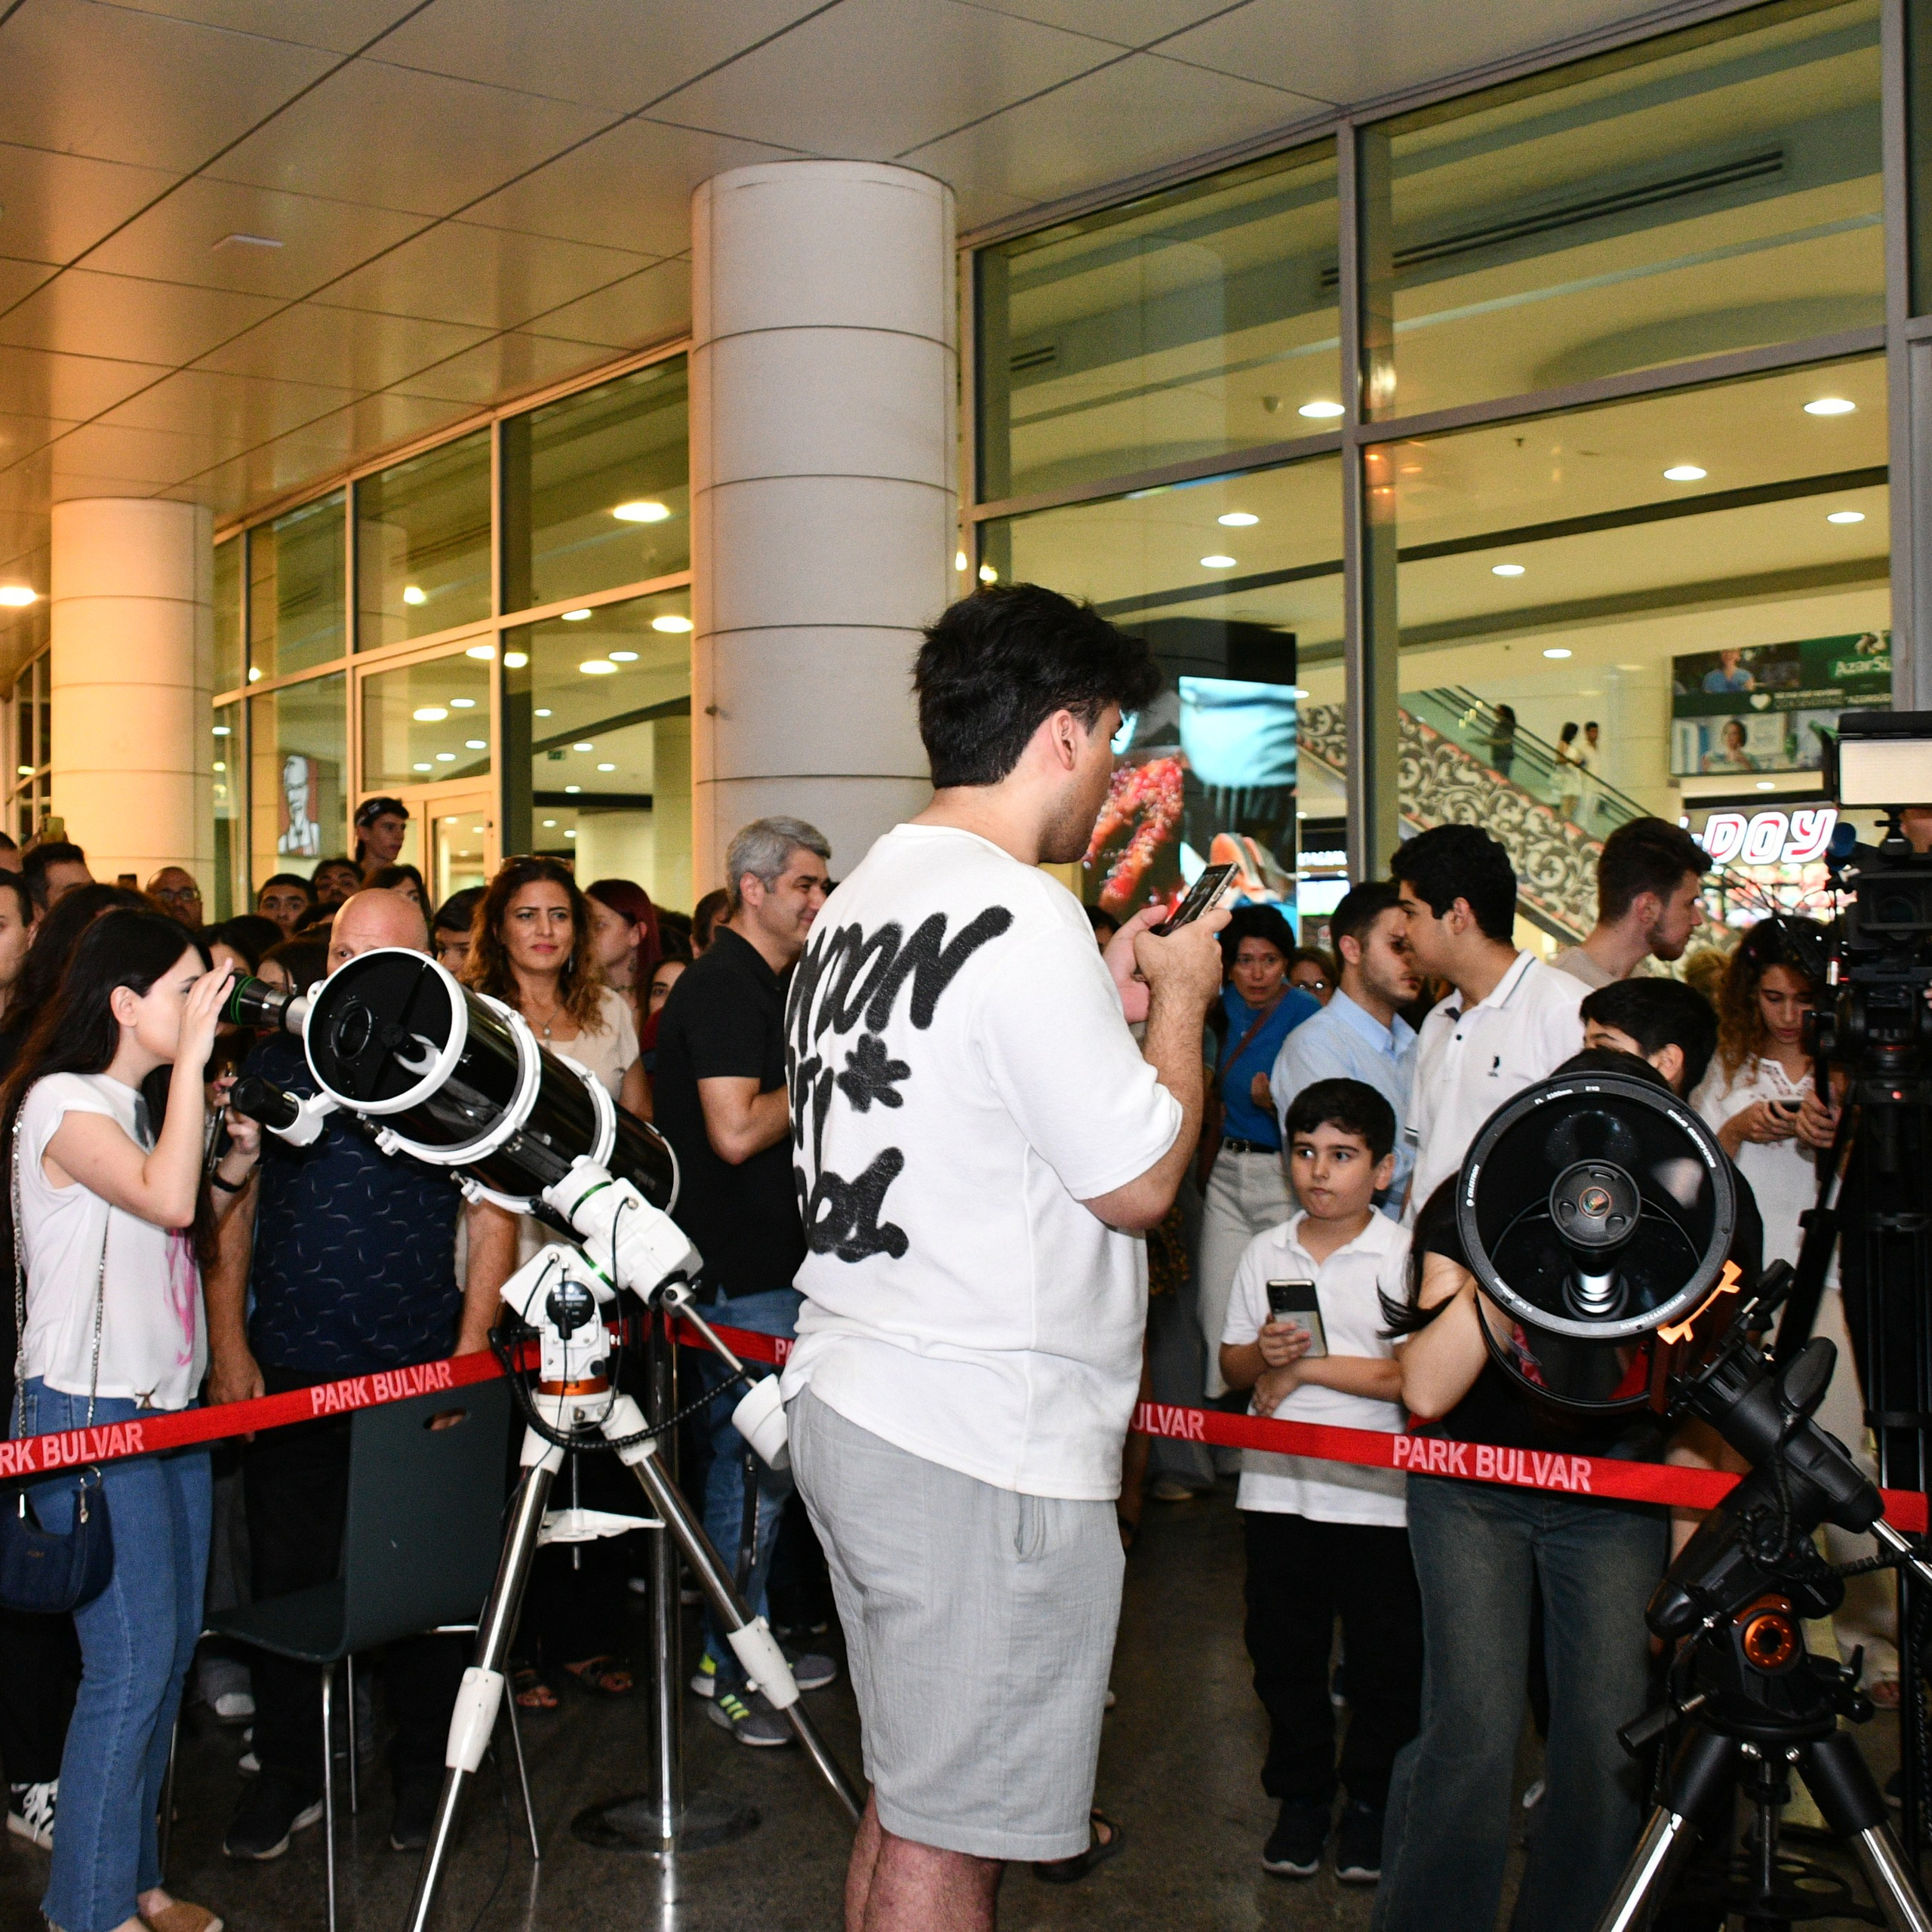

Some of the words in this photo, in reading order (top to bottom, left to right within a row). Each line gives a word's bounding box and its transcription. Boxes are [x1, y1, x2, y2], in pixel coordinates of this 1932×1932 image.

[1702, 808, 1838, 865] DOY
[1467, 1163, 1480, 1198] CELESTRON
[310, 1376, 371, 1416] PARK
[372, 1360, 454, 1401] BULVAR
[0, 1438, 36, 1475] RK
[42, 1422, 145, 1469] BULVAR
[1131, 1402, 1205, 1441] ULVAR
[1392, 1435, 1469, 1475] PARK
[1475, 1444, 1592, 1493] BULVAR
